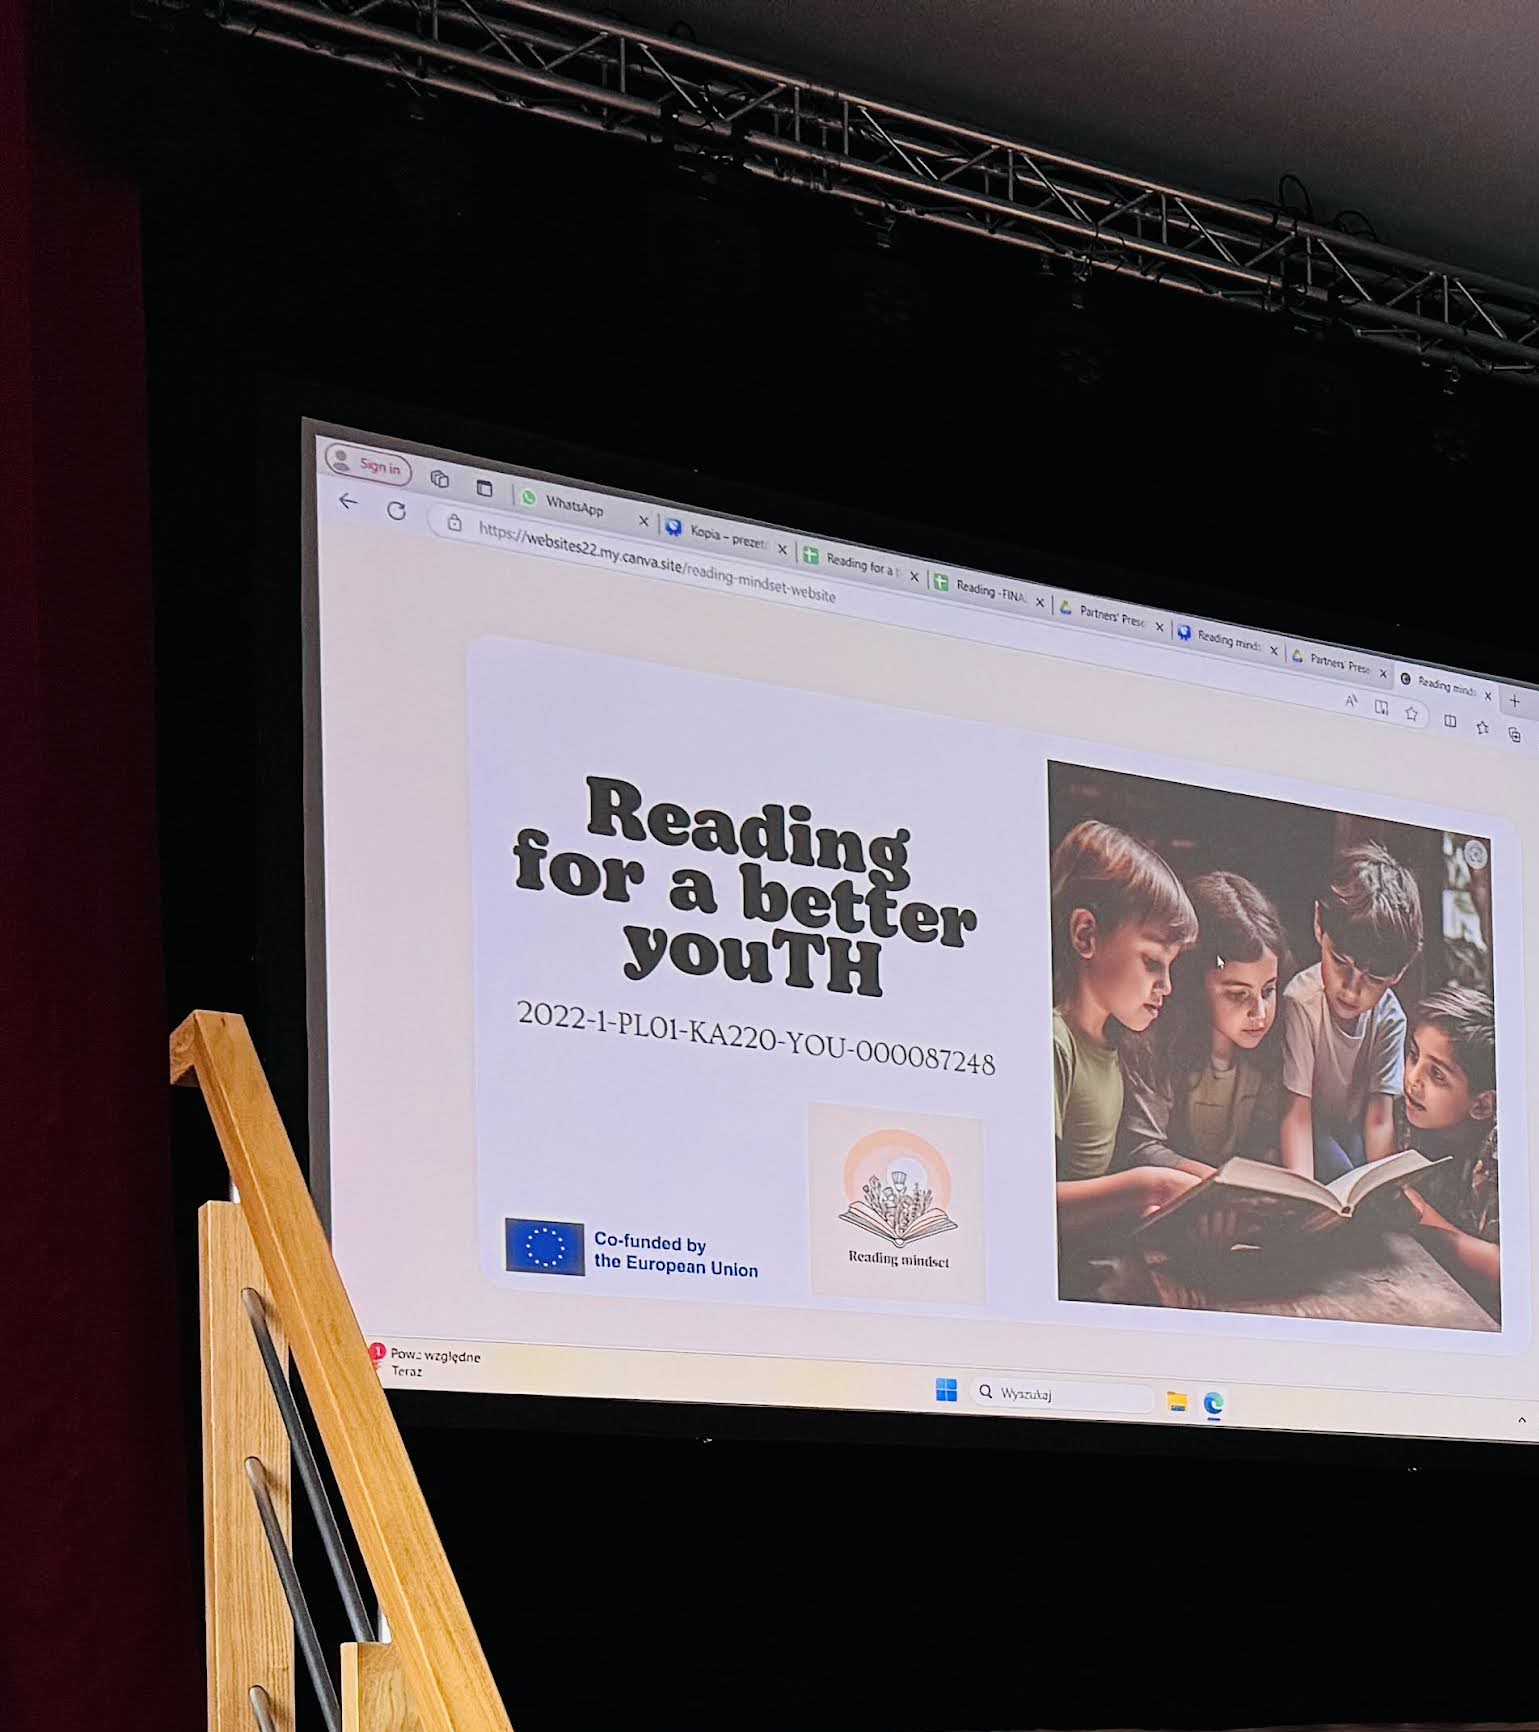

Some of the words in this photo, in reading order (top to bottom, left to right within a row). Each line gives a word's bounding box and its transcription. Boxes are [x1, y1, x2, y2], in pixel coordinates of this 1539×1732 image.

[360, 457, 386, 475] Sign
[389, 462, 400, 475] in
[546, 494, 604, 518] WhatsApp
[691, 523, 720, 541] Kopia
[479, 521, 837, 604] https://websites22.my.canva.site/reading-mindset-website
[827, 552, 868, 573] Reading
[870, 561, 885, 574] for
[887, 566, 894, 576] a
[957, 579, 996, 599] Reading
[1080, 604, 1120, 622] Partners'
[1198, 629, 1233, 649] Reading
[1418, 675, 1451, 694] Reading
[585, 775, 911, 892] Reading
[513, 828, 645, 903] for
[669, 867, 718, 914] a
[738, 861, 978, 949] better
[621, 924, 885, 999] youTH
[517, 999, 997, 1077] 2022-1-PL01-KA220-YOU-000087248
[594, 1231, 682, 1251] Co-funded
[687, 1237, 707, 1256] by
[594, 1253, 621, 1268] the
[626, 1255, 706, 1275] European
[711, 1260, 758, 1278] Union
[849, 1250, 899, 1267] Reading
[901, 1254, 950, 1268] mindset
[392, 1364, 423, 1377] Teraz
[1001, 1386, 1052, 1403] Wyszukaj
